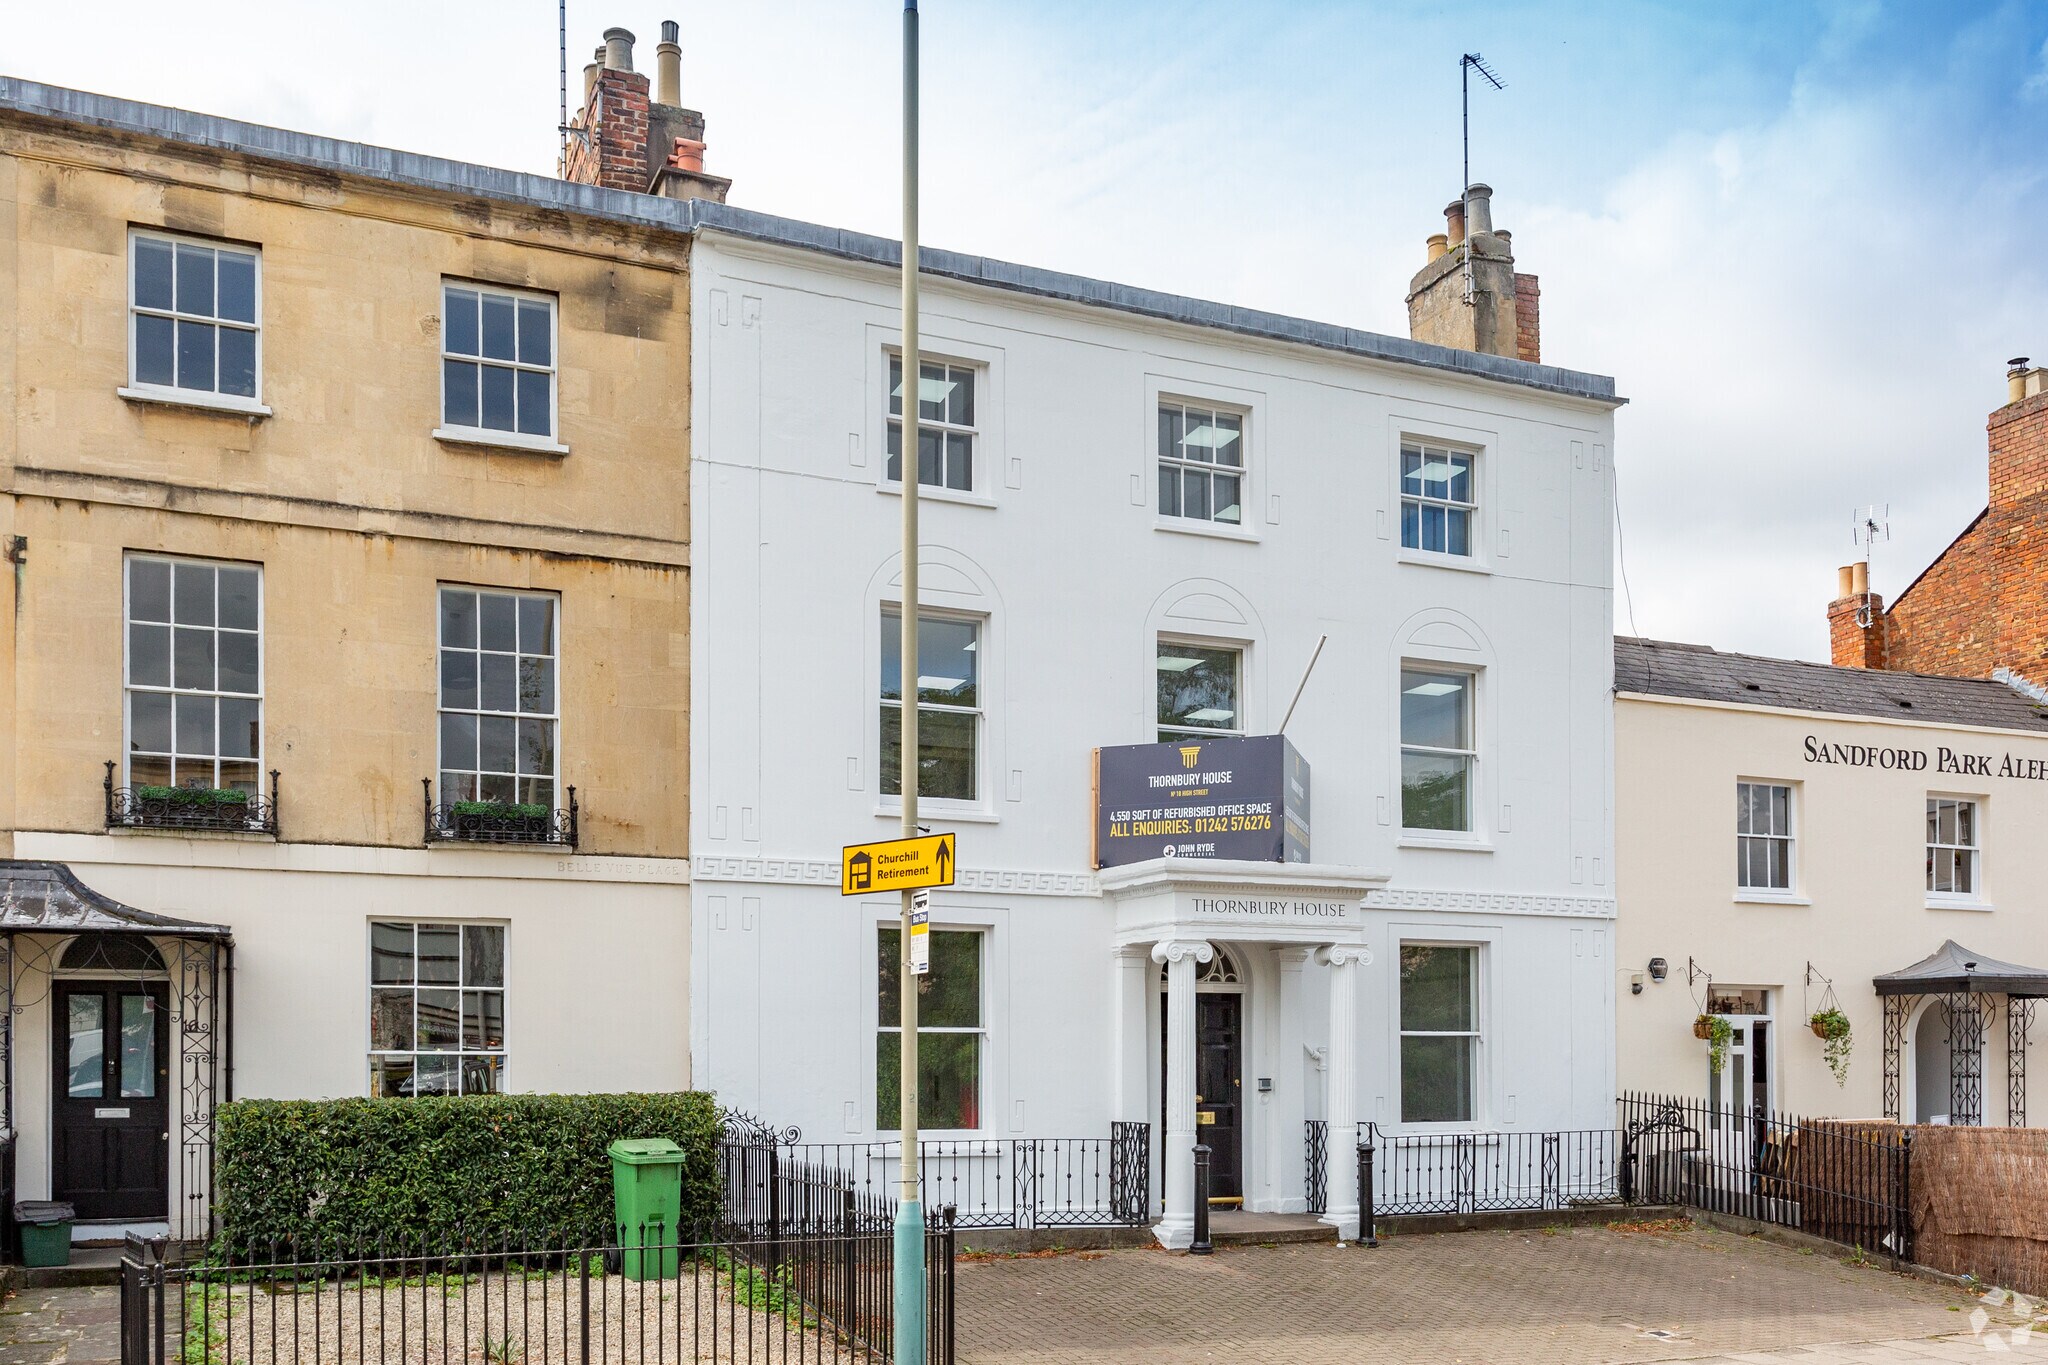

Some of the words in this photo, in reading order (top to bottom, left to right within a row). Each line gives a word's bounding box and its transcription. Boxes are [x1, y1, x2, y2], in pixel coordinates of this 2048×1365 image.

[1803, 735, 1928, 771] SANDFORD
[1936, 746, 1993, 777] PARK
[1148, 773, 1200, 788] THORNBURY
[1202, 771, 1232, 785] HOUSE
[1193, 788, 1209, 796] STREET
[1109, 811, 1131, 822] 4,550
[1132, 809, 1151, 821] SQFT
[1152, 809, 1163, 820] OF
[1164, 806, 1216, 819] REFURBISHED
[1217, 804, 1245, 816] OFFICE
[1246, 802, 1272, 815] SPACE
[1109, 823, 1130, 837] ALL
[1133, 819, 1192, 836] ENQUIRIES:
[1195, 817, 1228, 833] 01242
[1231, 815, 1271, 832] 576276
[1177, 844, 1195, 853] JOHN
[1196, 842, 1215, 852] RYDE
[877, 850, 919, 865] Churchill
[557, 861, 601, 873] BELLE
[606, 862, 633, 874] VUE
[638, 864, 680, 876] PLACE
[877, 865, 930, 880] Retirement
[1191, 898, 1289, 916] THORNBURY
[1293, 901, 1346, 918] HOUSE
[919, 913, 927, 923] Stop
